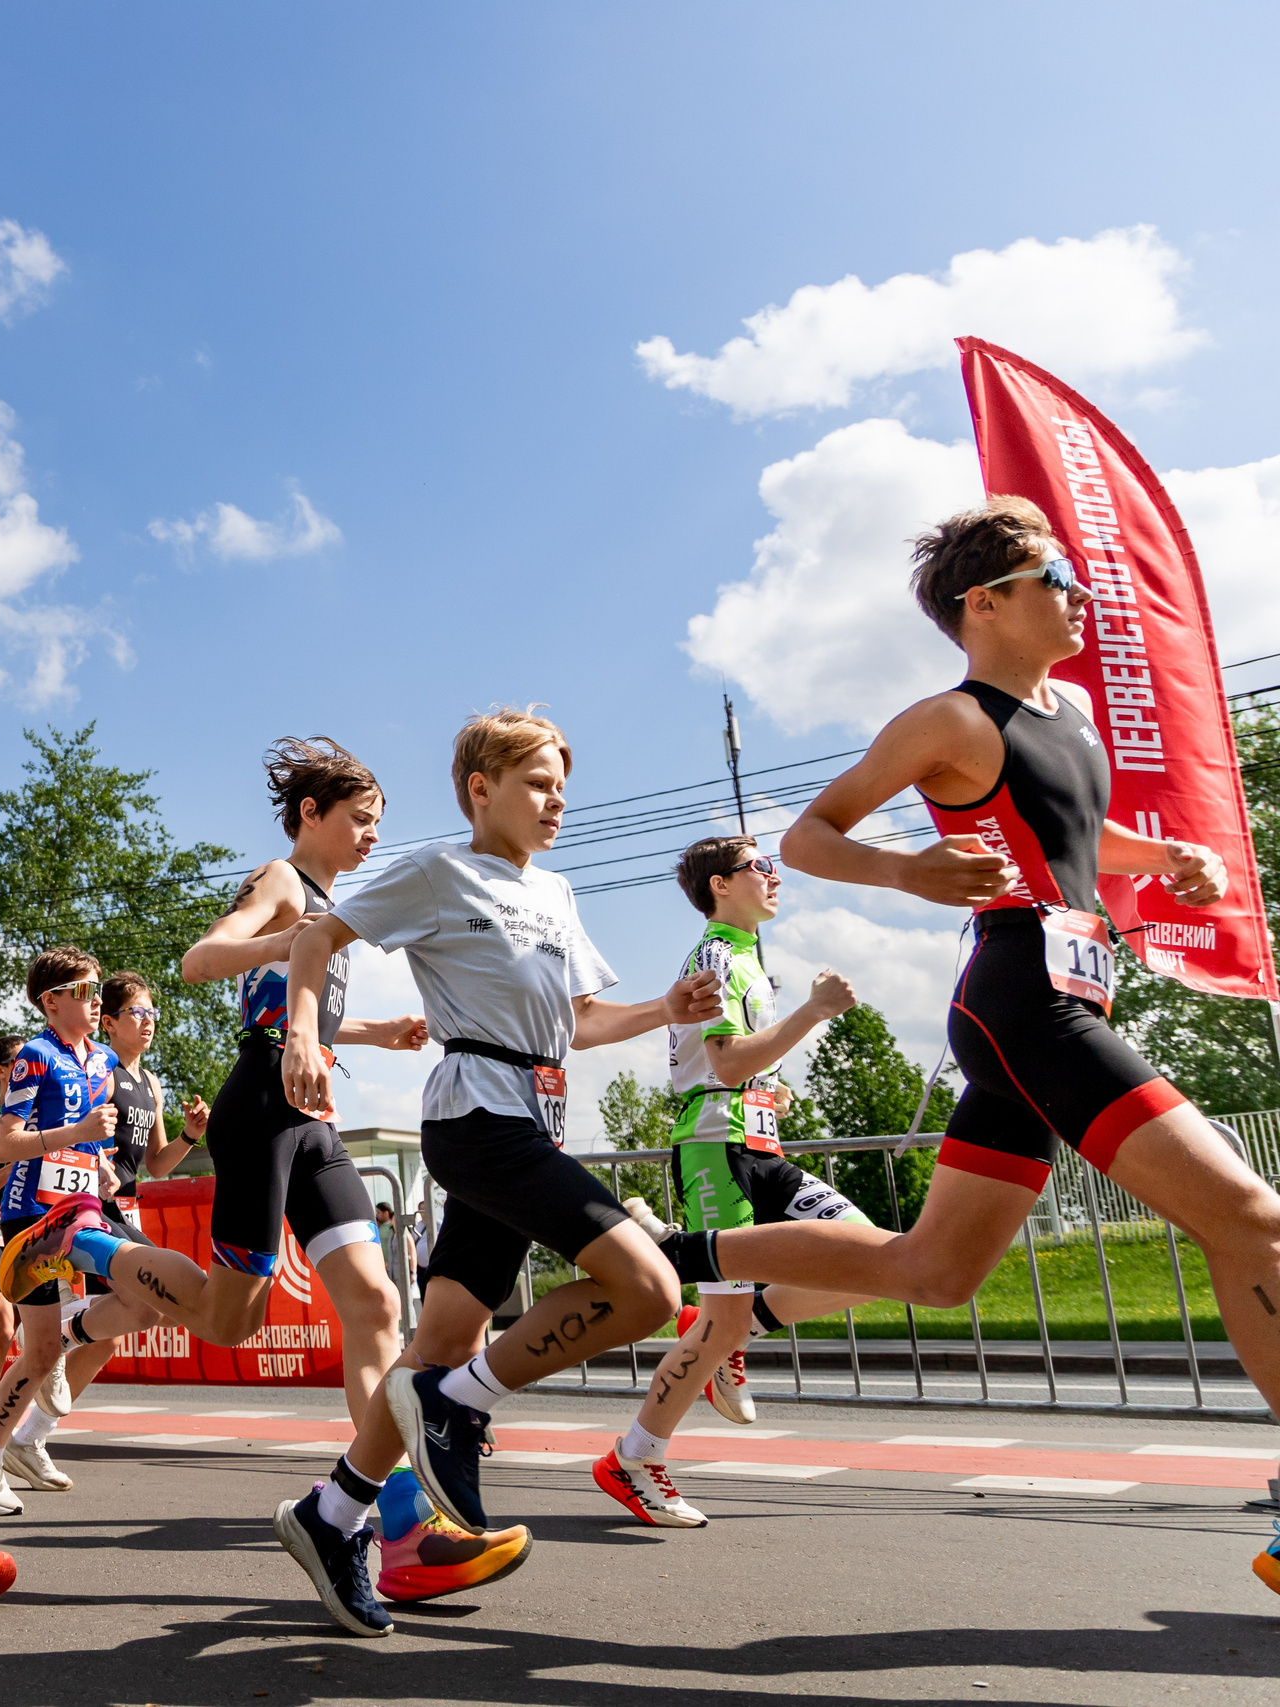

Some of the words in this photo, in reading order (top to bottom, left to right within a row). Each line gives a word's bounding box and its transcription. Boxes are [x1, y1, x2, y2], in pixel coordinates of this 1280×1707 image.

[1051, 416, 1124, 553] МОСКВЫ
[1087, 559, 1166, 773] ПЕРВЕНСТВО
[466, 918, 494, 933] THE
[510, 934, 531, 947] THE
[1144, 922, 1215, 950] ОВСКИЙ
[1067, 939, 1109, 991] 111
[327, 984, 343, 1018] RUS
[53, 1168, 91, 1194] 132
[232, 1319, 331, 1349] ОСКОВСКИЙ
[525, 1300, 614, 1357] 105
[258, 1354, 305, 1377] СПОРТ
